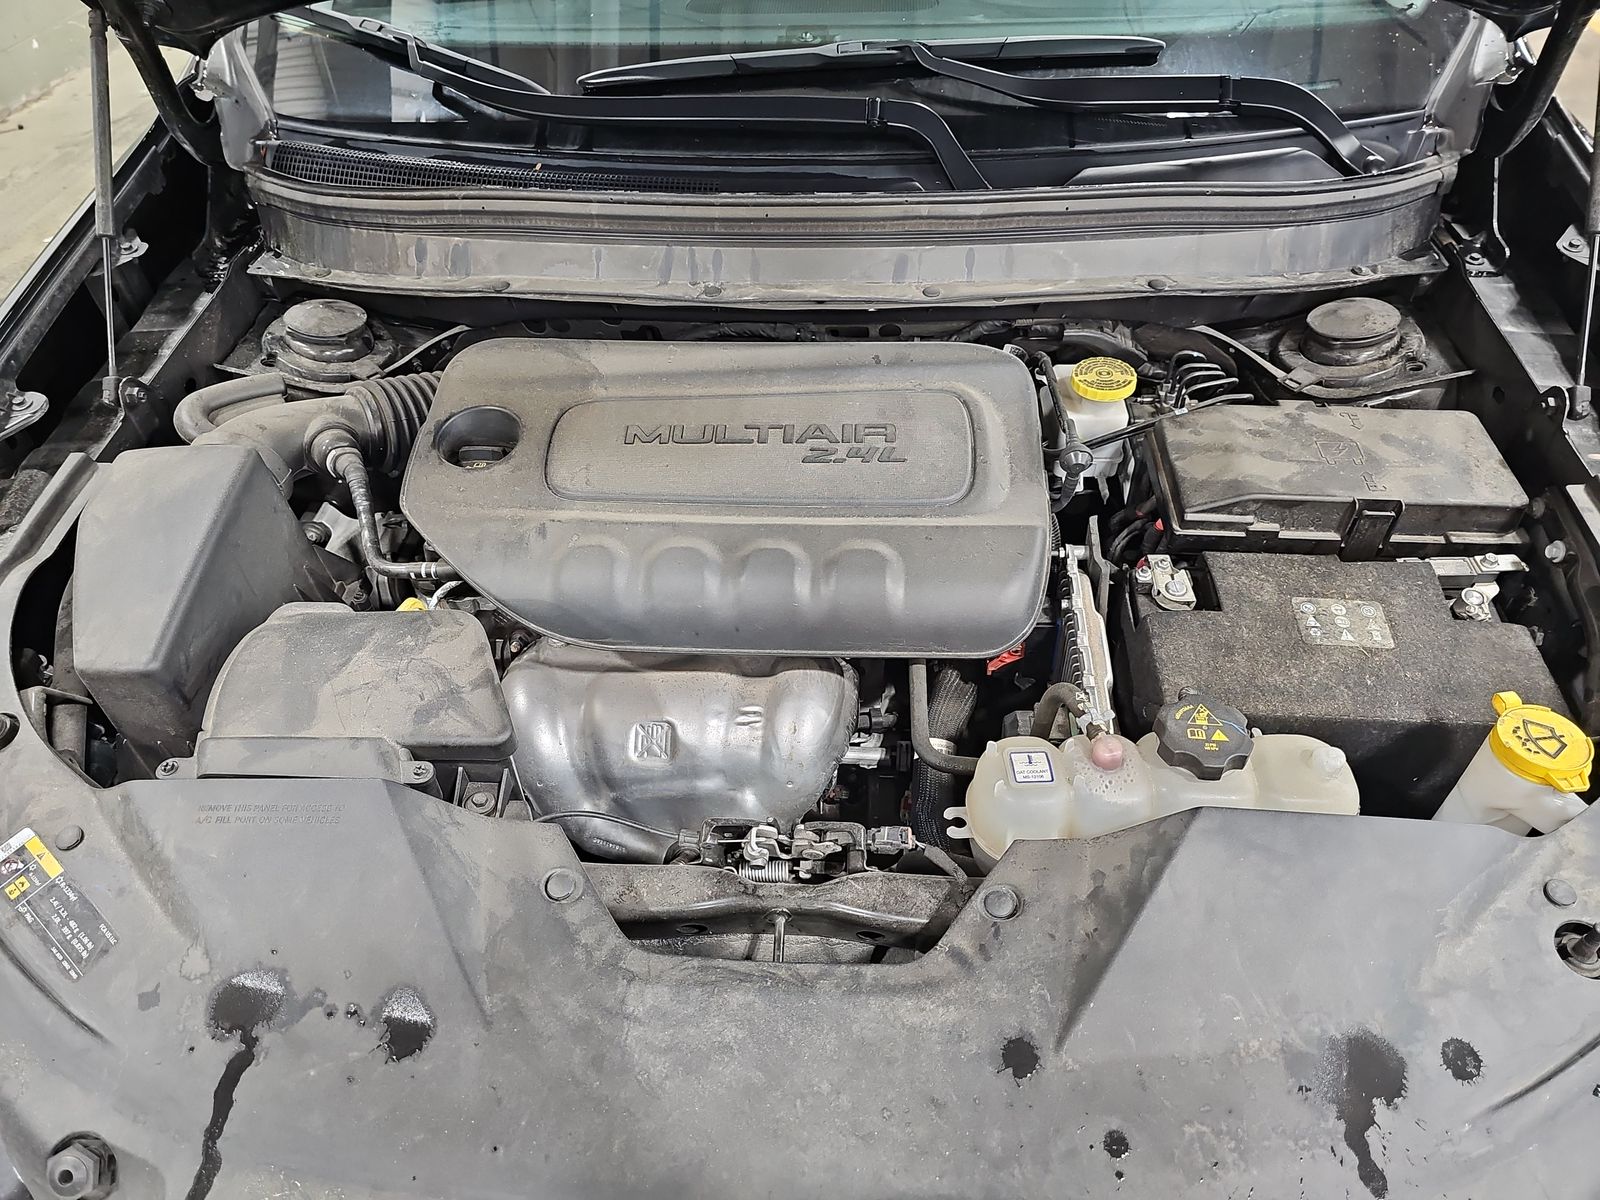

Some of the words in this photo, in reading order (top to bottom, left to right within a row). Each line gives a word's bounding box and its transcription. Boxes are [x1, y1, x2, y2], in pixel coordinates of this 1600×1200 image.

[623, 423, 897, 445] MULTIAIR
[801, 446, 908, 464] 2.4L
[215, 815, 232, 825] FILL
[258, 815, 273, 825] ON
[24, 912, 35, 924] PAG
